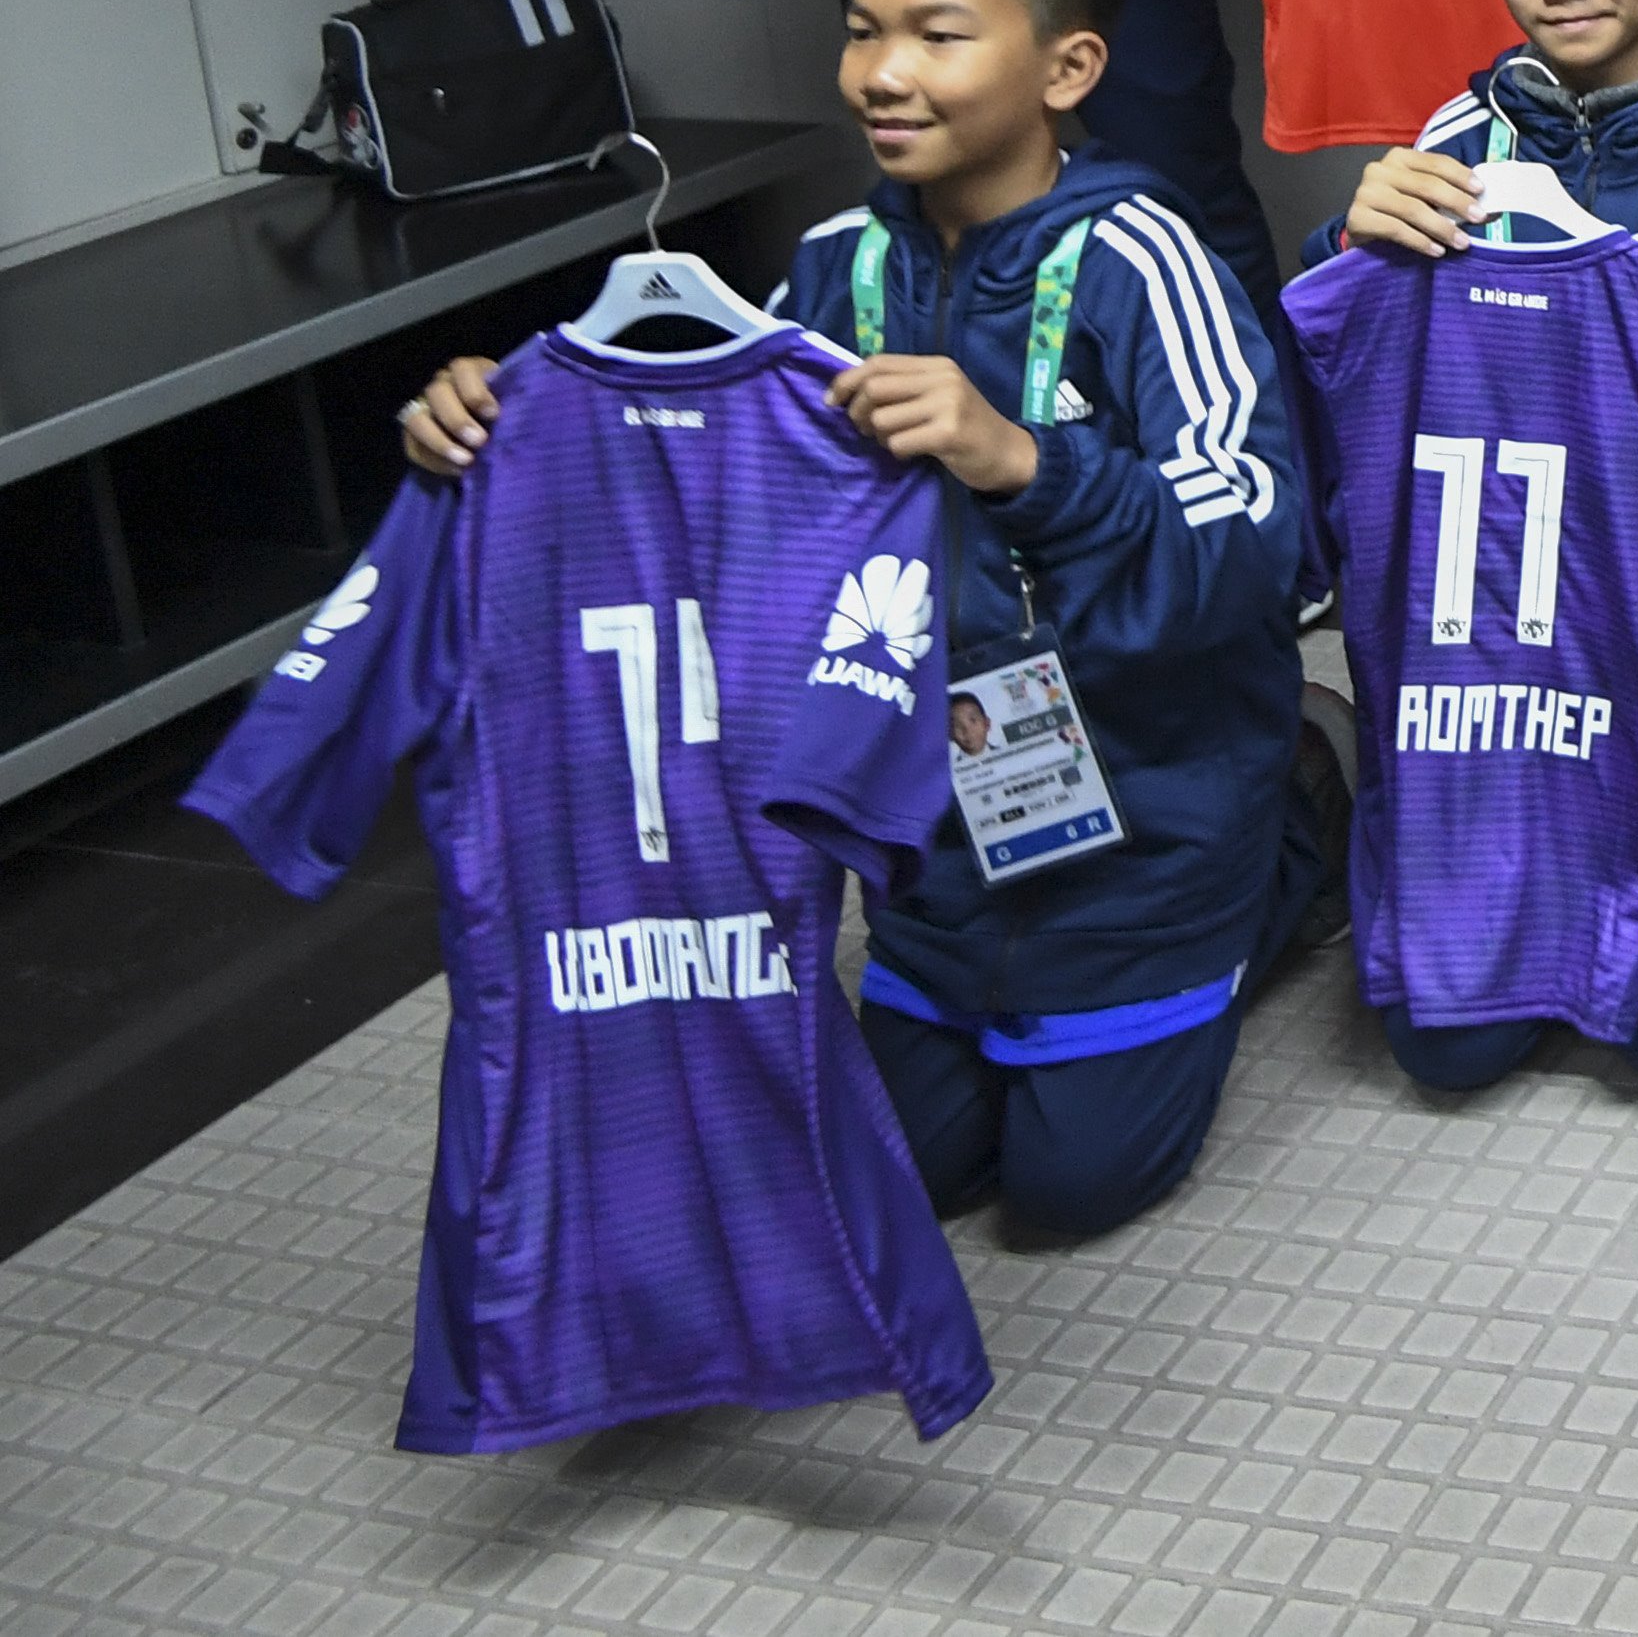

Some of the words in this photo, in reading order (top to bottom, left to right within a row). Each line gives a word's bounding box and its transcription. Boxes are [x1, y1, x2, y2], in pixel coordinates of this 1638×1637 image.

[1470, 286, 1482, 303] EL
[1508, 290, 1549, 311] GRANDE
[1413, 433, 1568, 647] 11
[1396, 683, 1613, 761] ROMTHEP
